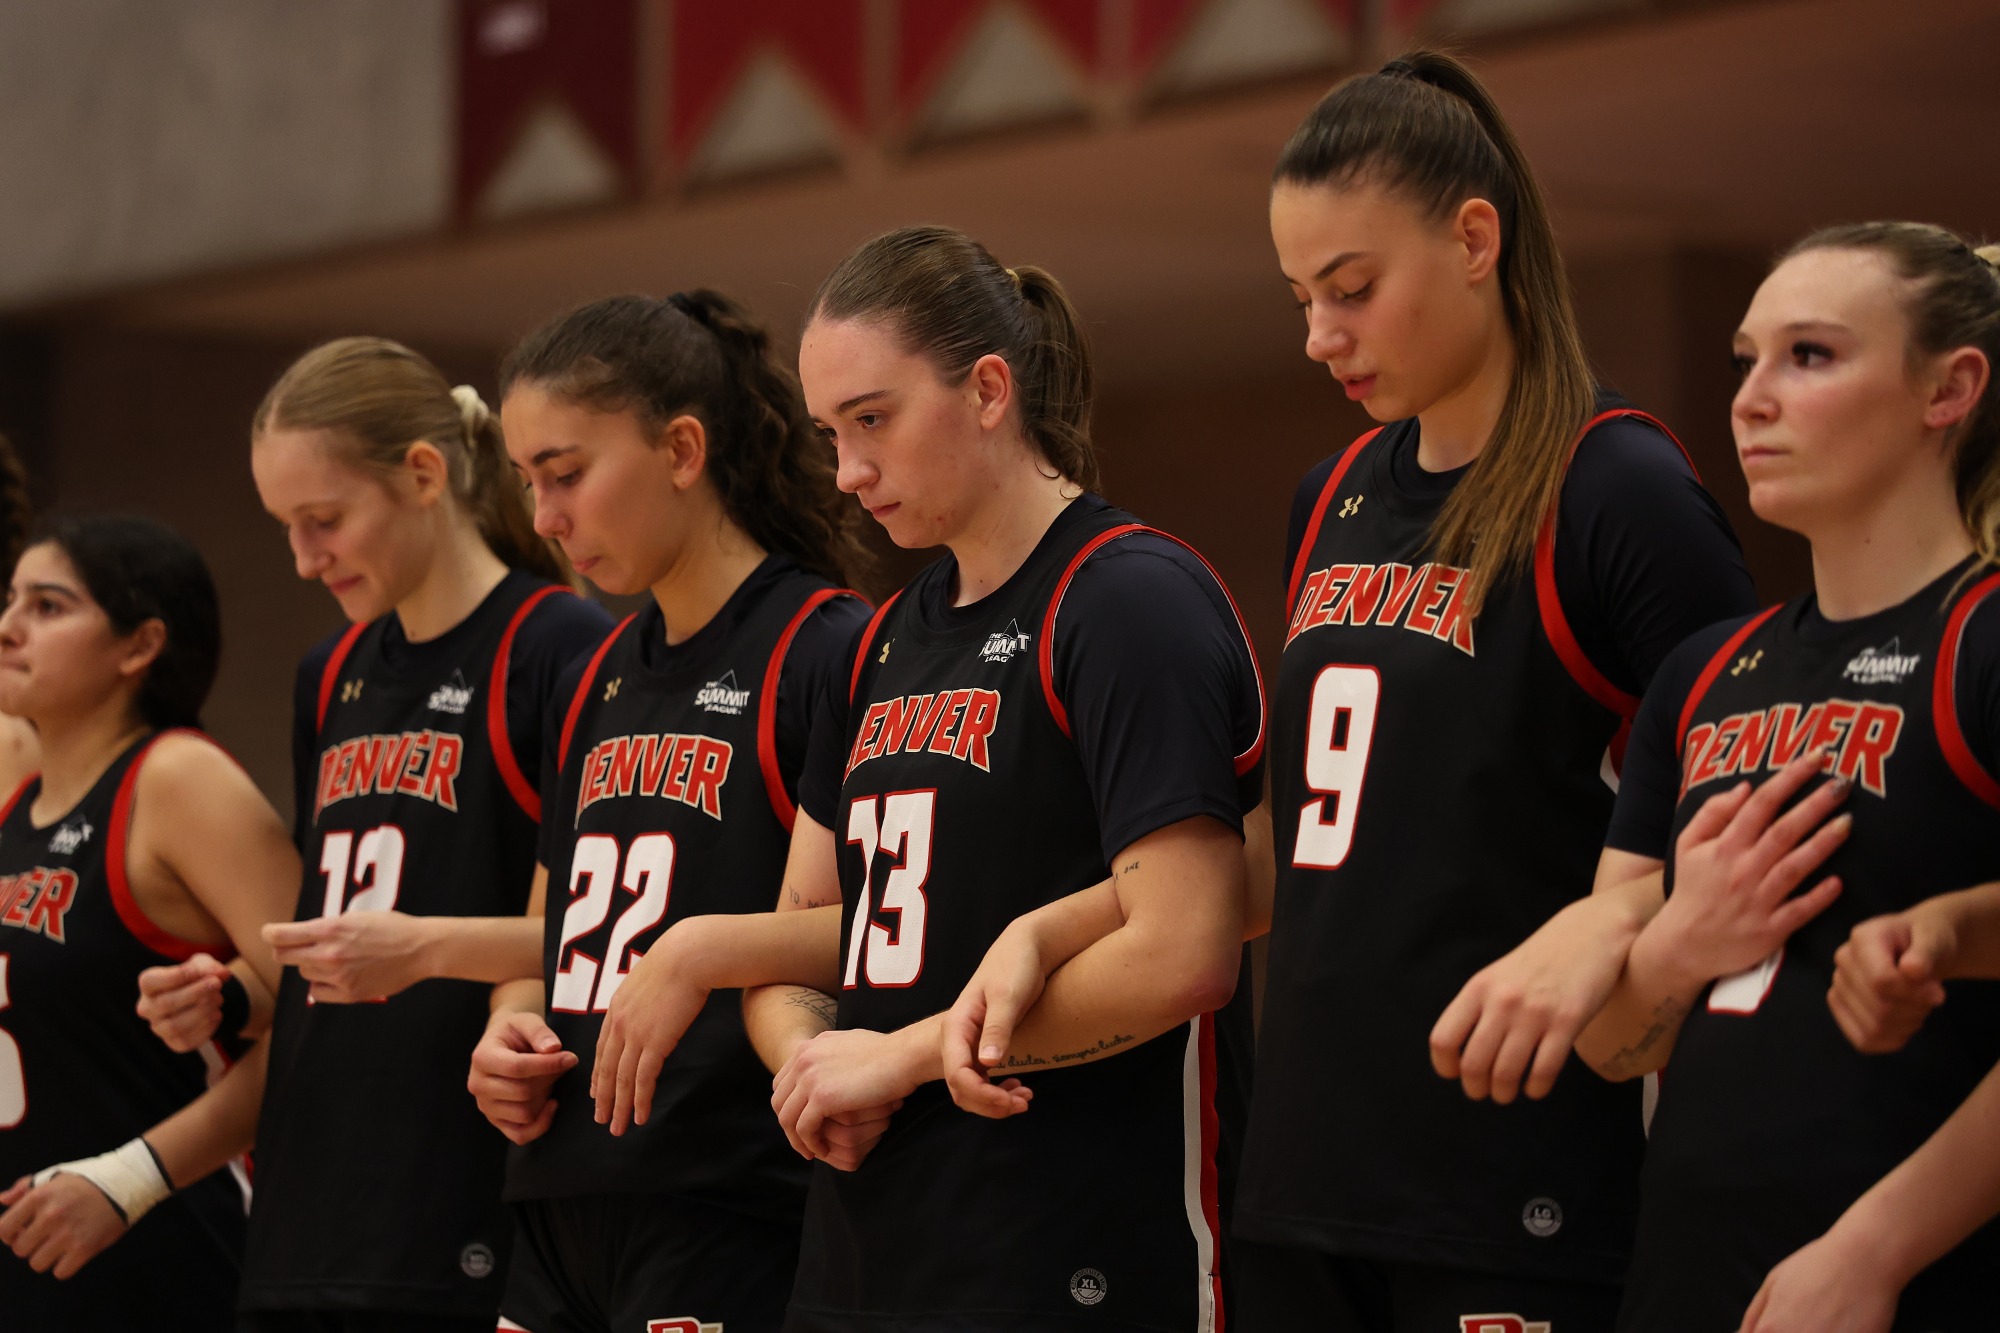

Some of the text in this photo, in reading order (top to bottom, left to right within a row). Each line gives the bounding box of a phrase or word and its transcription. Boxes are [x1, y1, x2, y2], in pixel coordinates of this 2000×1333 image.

[1283, 562, 1475, 657] DENVER
[694, 688, 750, 707] SUMMIT
[842, 688, 1001, 790] ENVER
[1291, 663, 1382, 870] 9
[1677, 698, 1905, 808] DENVER
[552, 831, 677, 1014] 22
[1098, 1034, 1135, 1050] lucha
[1081, 1278, 1097, 1288] XL
